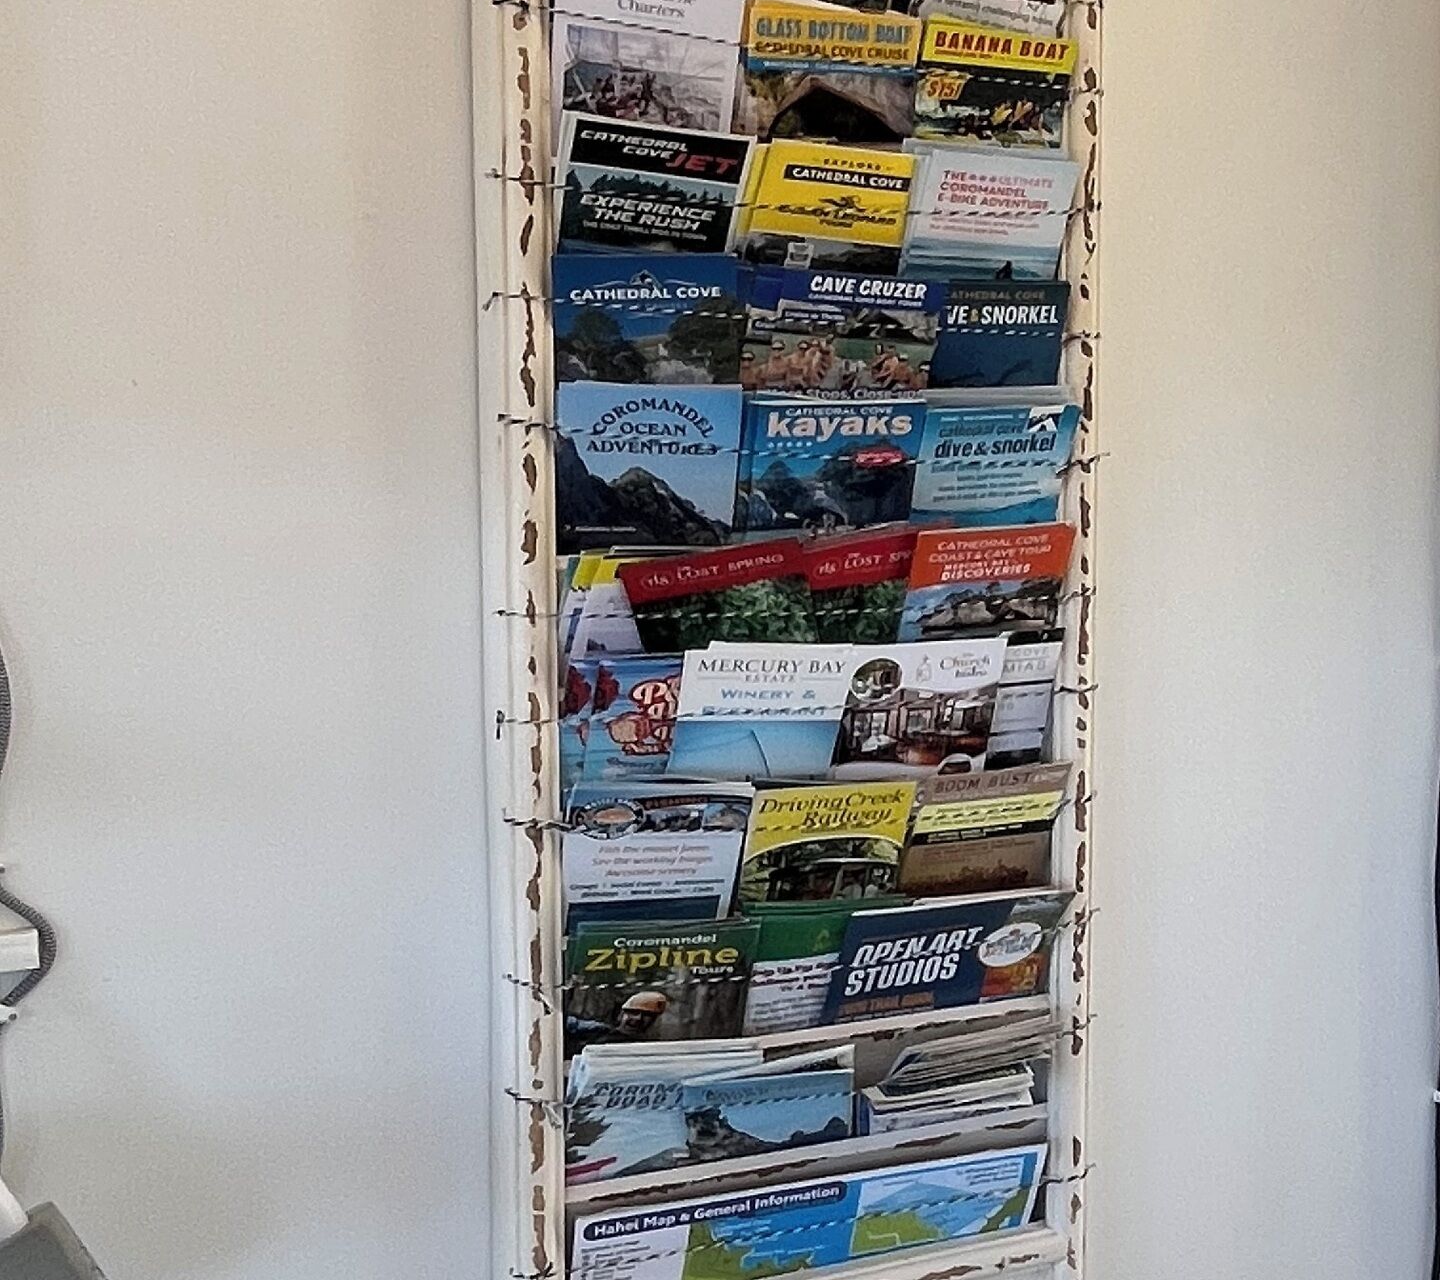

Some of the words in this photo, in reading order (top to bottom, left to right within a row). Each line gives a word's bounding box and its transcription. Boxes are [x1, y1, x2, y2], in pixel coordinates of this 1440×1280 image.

[832, 47, 864, 60] COVE
[868, 48, 910, 60] CRUISE
[935, 31, 1013, 55] BANANA
[1019, 40, 1070, 61] BOAT
[580, 130, 689, 152] CATHEDRAL
[622, 146, 675, 160] COVE
[666, 153, 739, 175] JET
[792, 168, 866, 185] CATHEDRAL
[869, 177, 903, 189] COVE
[939, 181, 1028, 198] COROMANDEL
[580, 194, 717, 222] EXPERIENCE
[593, 207, 636, 223] THE
[638, 214, 701, 231] RUSH
[569, 287, 672, 302] CATHEDRAL
[676, 286, 722, 298] COVE
[810, 275, 857, 293] CAVE
[859, 279, 928, 300] CRUZER
[950, 289, 1012, 300] ATHEDRAL
[947, 306, 969, 325] VE
[981, 305, 1059, 325] SNORKEL
[590, 397, 716, 439] COROMANDEL
[785, 408, 854, 417] CATHEDRAL
[860, 406, 894, 416] COVE
[619, 421, 688, 437] OCEAN
[767, 412, 913, 443] kayaks
[586, 438, 719, 456] ADVENTURES
[934, 439, 972, 459] dive
[990, 433, 1058, 456] snorkel
[937, 539, 1012, 552] CATHEDRAL
[1016, 533, 1050, 546] COVE
[727, 553, 786, 572] SPRING
[843, 555, 884, 570] LOST
[889, 551, 913, 564] SPR
[928, 552, 973, 564] COAST
[983, 549, 1016, 559] CAVE
[941, 564, 1032, 582] DISCOVERIES
[698, 659, 804, 674] MERCURY
[808, 660, 848, 675] BAY
[745, 675, 797, 683] ESTATE
[720, 688, 795, 700] WINERY
[801, 689, 816, 699] &
[845, 789, 906, 807] Creek
[801, 809, 893, 828] Railway
[613, 933, 718, 948] Coromandel
[849, 935, 928, 968] OPEN
[928, 926, 985, 957] ART
[585, 945, 739, 976] Zipline
[691, 965, 734, 975] Tours
[844, 953, 961, 997] STUDIOS
[594, 1221, 640, 1237] Hahei
[644, 1214, 676, 1229] Map
[679, 1212, 691, 1223] &
[694, 1202, 751, 1220] General
[754, 1187, 841, 1210] Information
